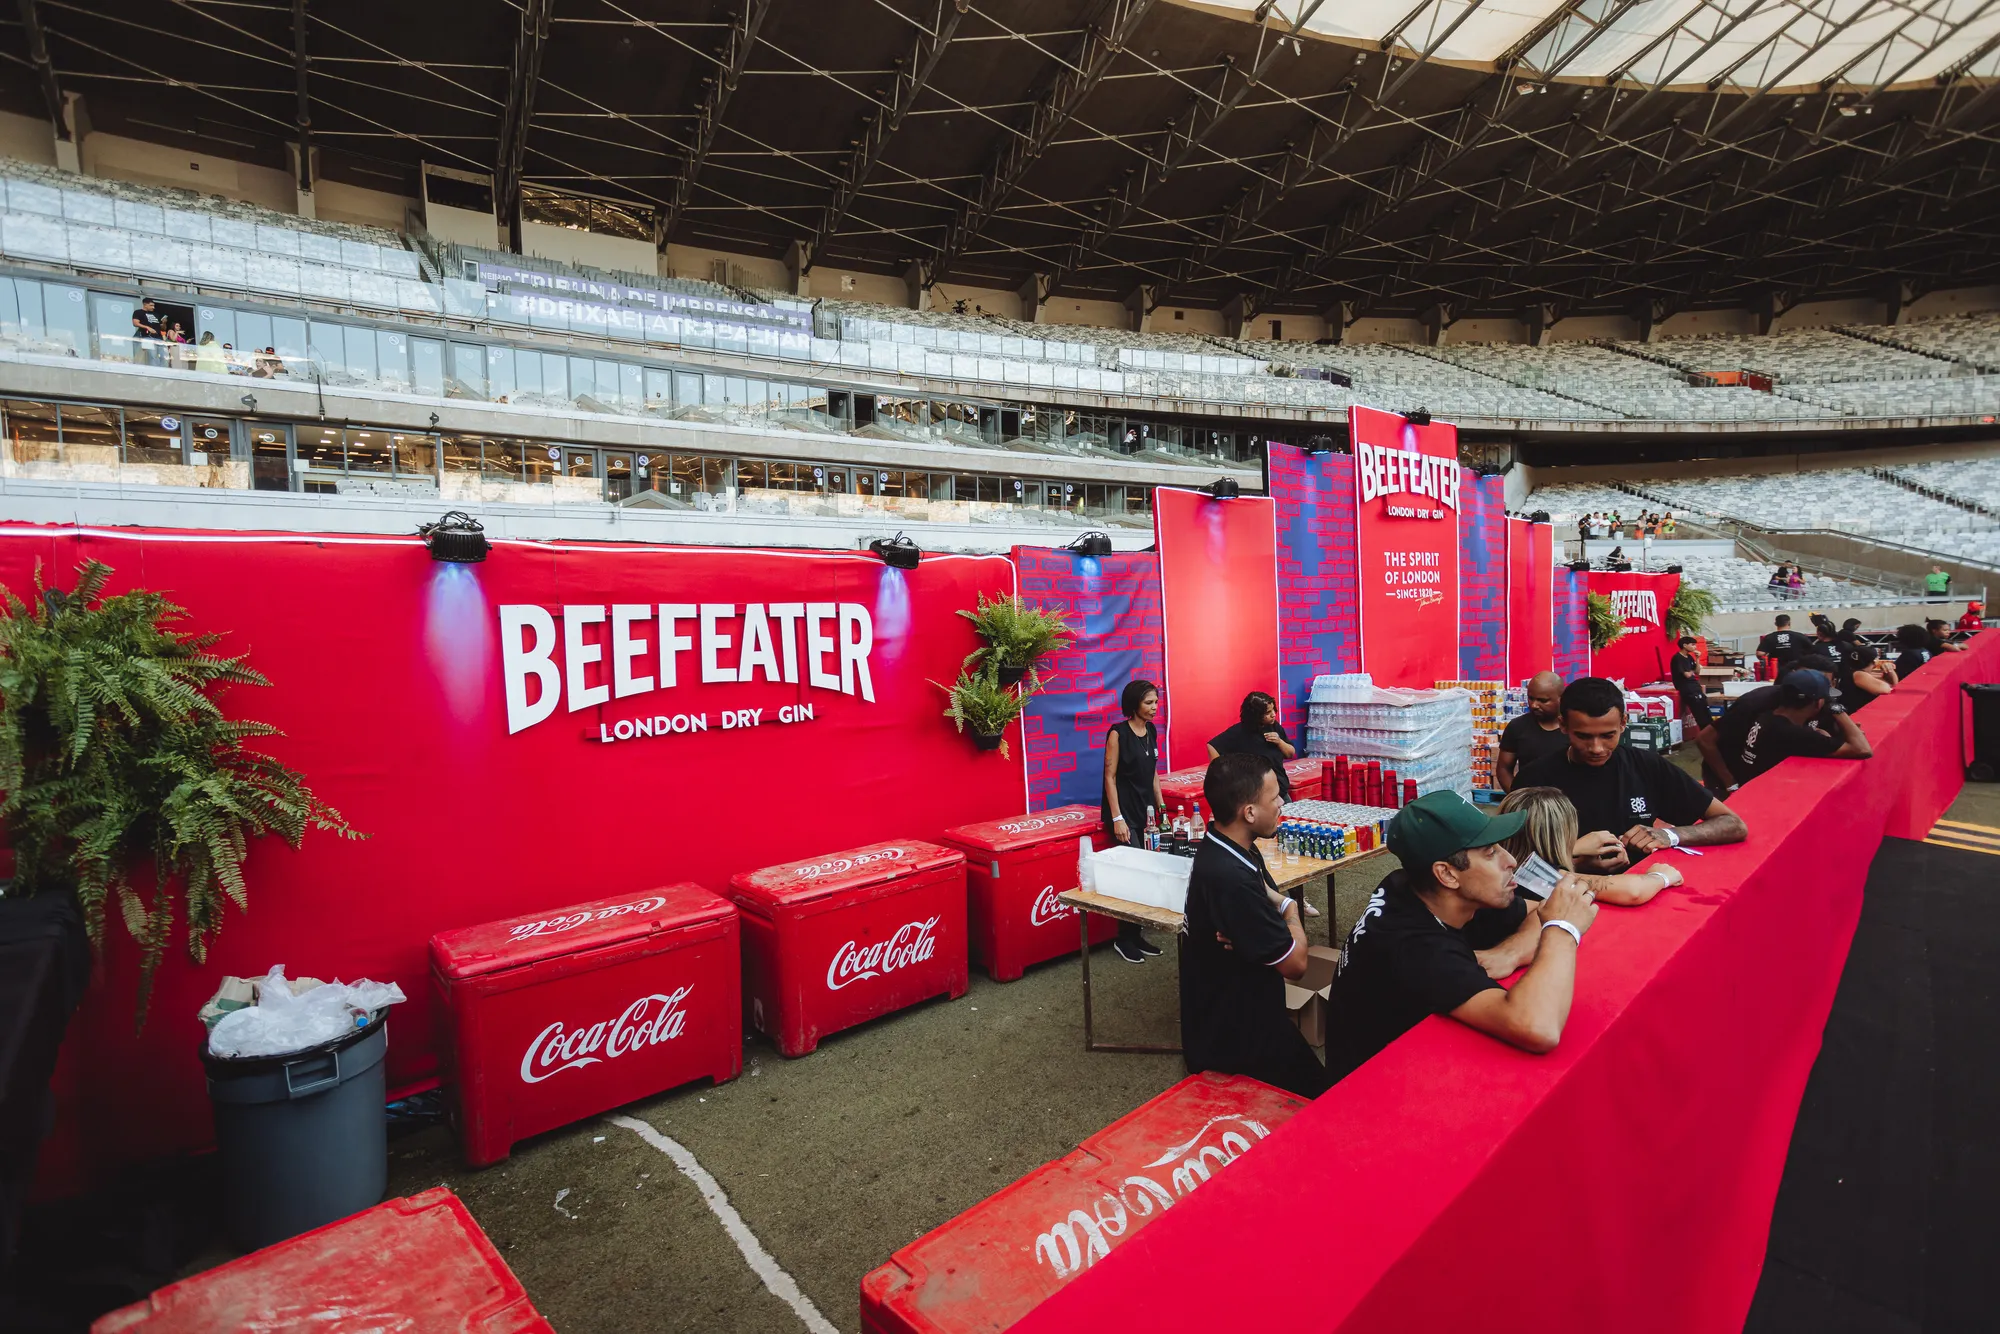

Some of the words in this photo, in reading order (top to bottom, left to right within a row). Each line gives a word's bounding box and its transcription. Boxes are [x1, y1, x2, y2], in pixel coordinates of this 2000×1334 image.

[1359, 442, 1461, 516] BEEFEATER
[1387, 505, 1415, 518] LONDON
[1417, 508, 1429, 519] DRY
[1432, 509, 1444, 519] GIN
[1384, 552, 1407, 567] THE
[1409, 552, 1440, 567] SPIRIT
[1385, 571, 1399, 585] OF
[1402, 570, 1441, 584] LONDON
[1396, 588, 1417, 599] SINCE
[1419, 588, 1433, 598] 1820
[499, 602, 876, 735] BEEFEATER
[600, 712, 707, 743] LONDON
[721, 708, 763, 730] DRY
[778, 703, 814, 724] GIN
[998, 811, 1085, 835] Coca-Cola
[794, 848, 904, 881] Coca-Cola
[505, 897, 667, 944] Coca-Cola
[827, 914, 941, 991] Coca-Cola
[520, 983, 695, 1084] Coca-Cola
